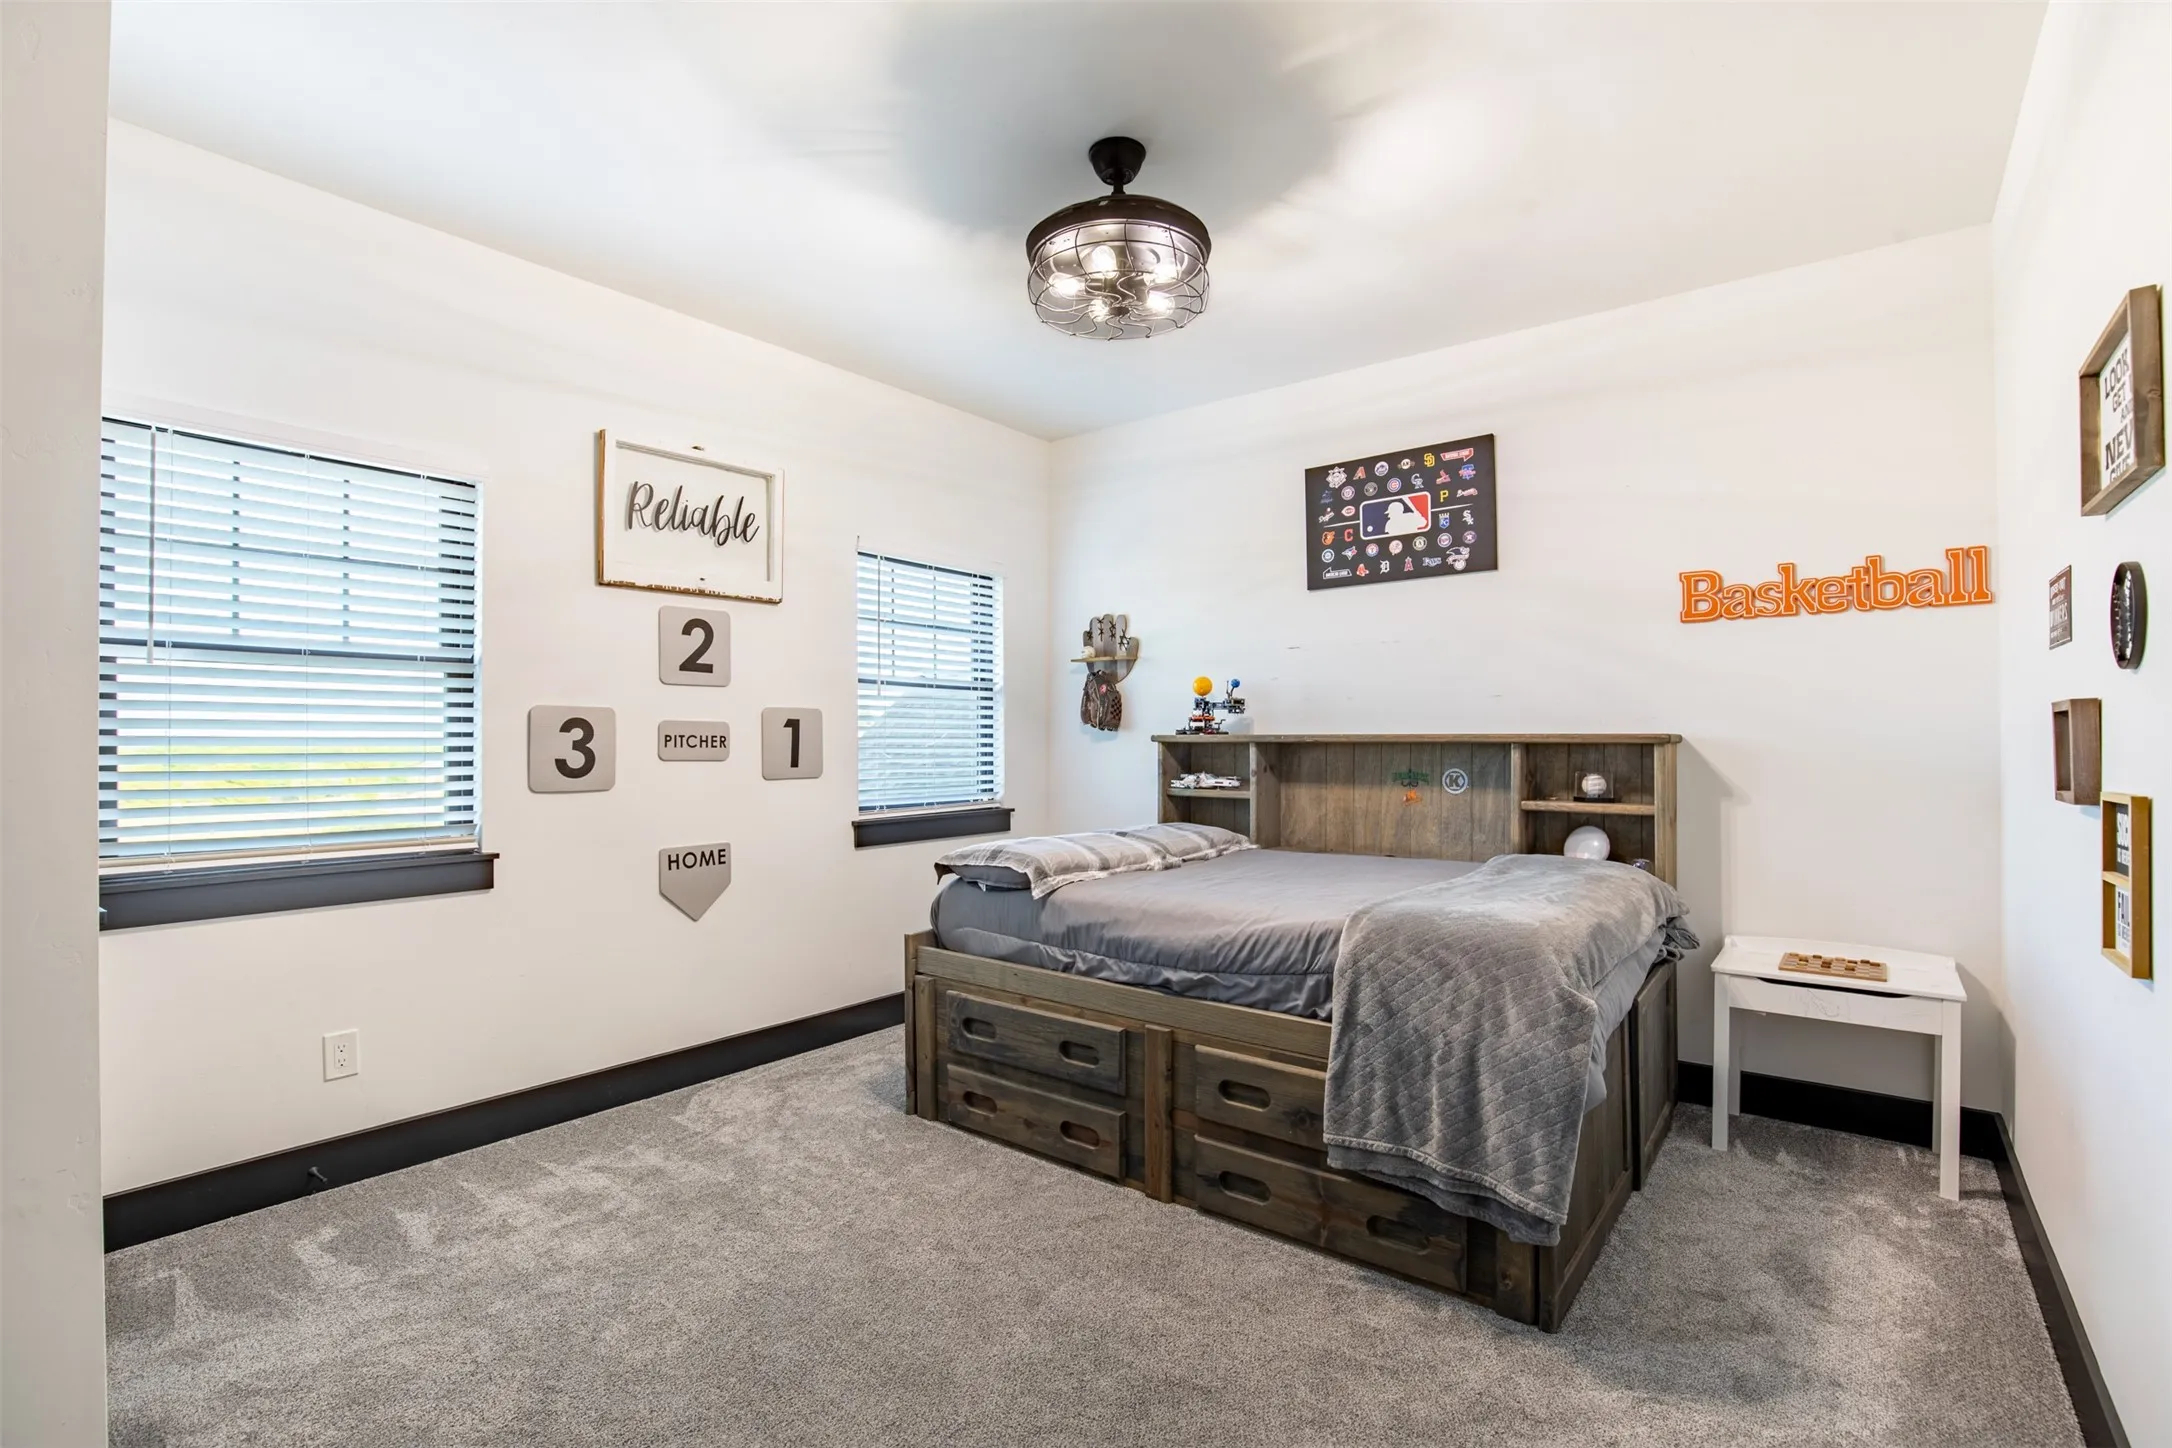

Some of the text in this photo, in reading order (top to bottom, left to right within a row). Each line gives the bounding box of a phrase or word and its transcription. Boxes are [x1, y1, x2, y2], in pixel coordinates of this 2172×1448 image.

[2105, 419, 2133, 470] NEV
[627, 480, 760, 548] Reliable
[1440, 489, 1449, 503] P
[1678, 544, 1994, 624] Basketball
[678, 617, 715, 674] 2
[554, 717, 596, 779] 3
[663, 733, 728, 750] PITCHER
[782, 718, 801, 769] 1
[1447, 772, 1462, 790] K
[666, 848, 728, 872] HOME
